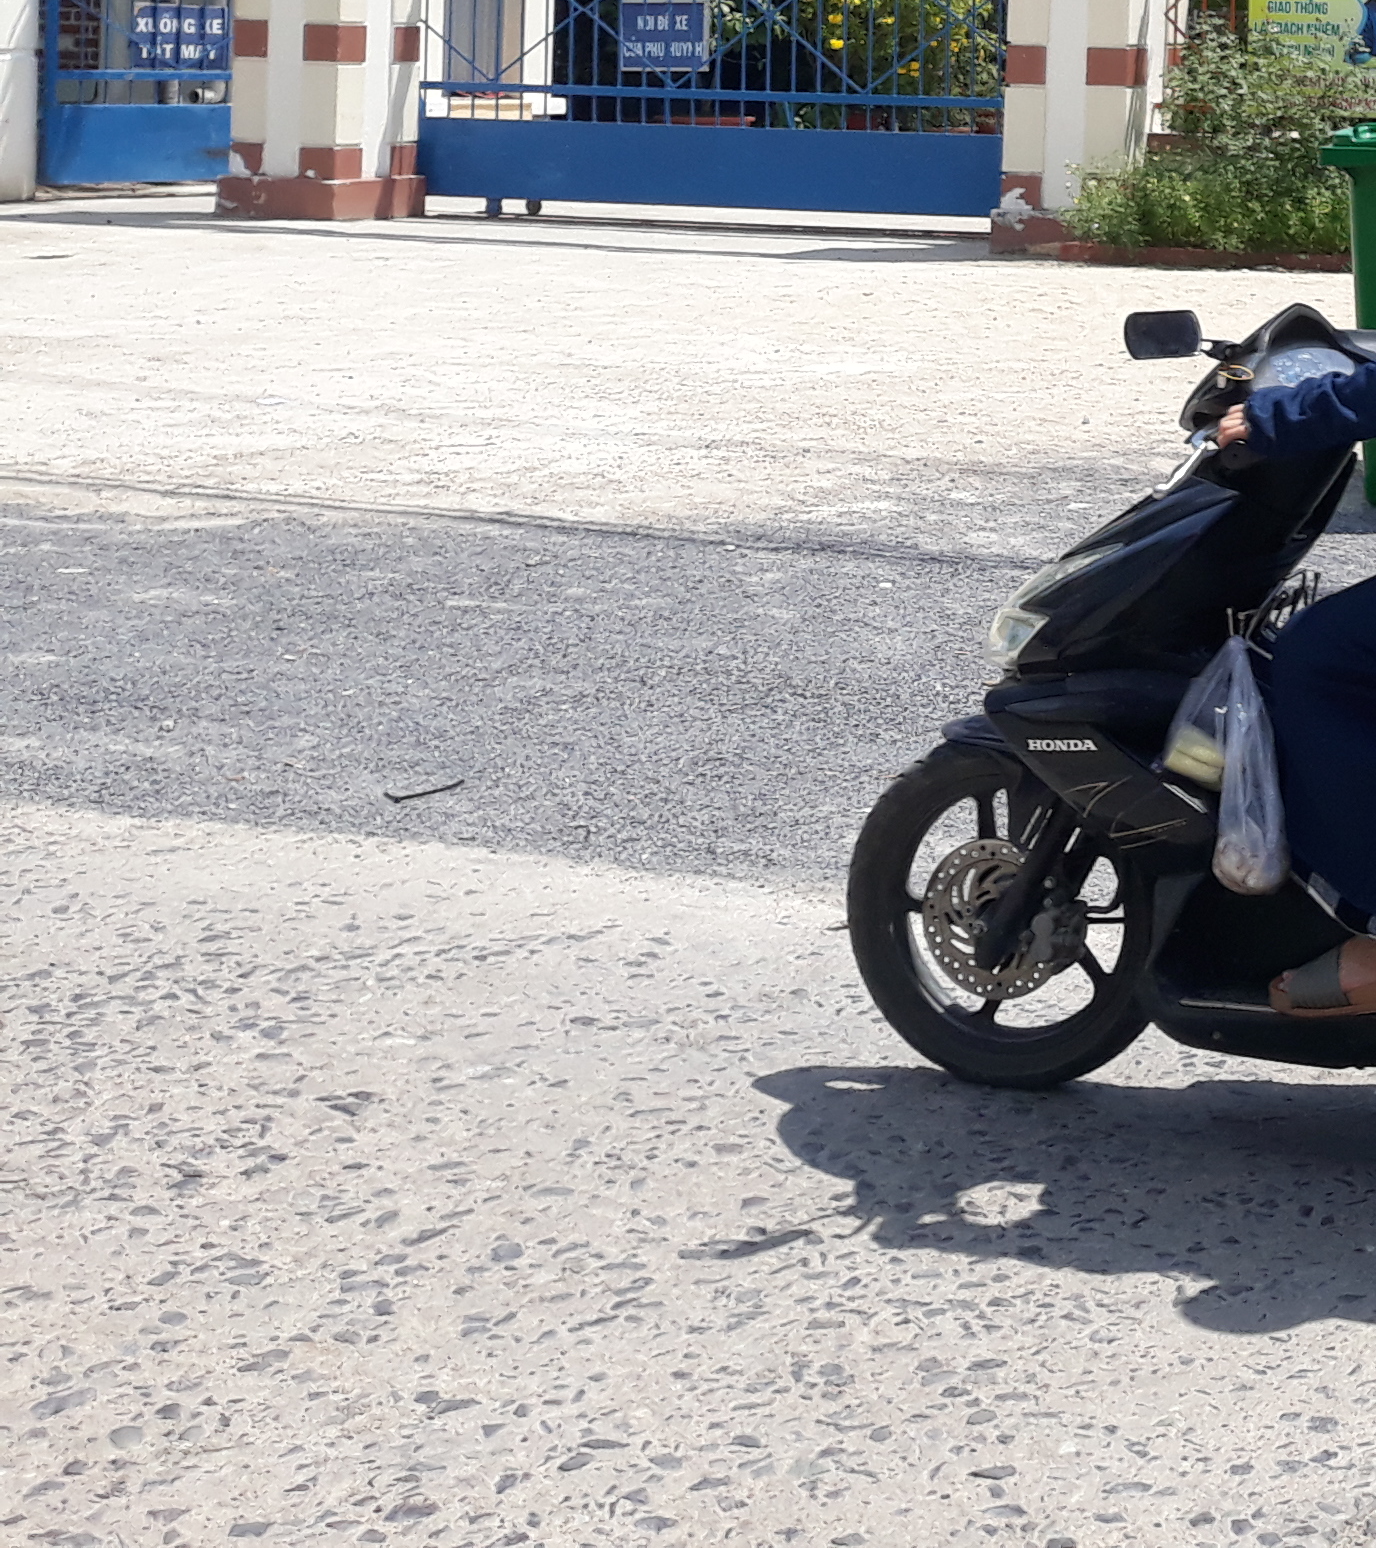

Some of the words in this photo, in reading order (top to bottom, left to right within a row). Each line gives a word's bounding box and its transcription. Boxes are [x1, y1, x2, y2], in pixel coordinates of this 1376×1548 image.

[1267, 0, 1291, 14] GIAO
[1294, 0, 1329, 15] THÔNG
[674, 14, 689, 30] XE
[1026, 738, 1098, 752] HONDA
